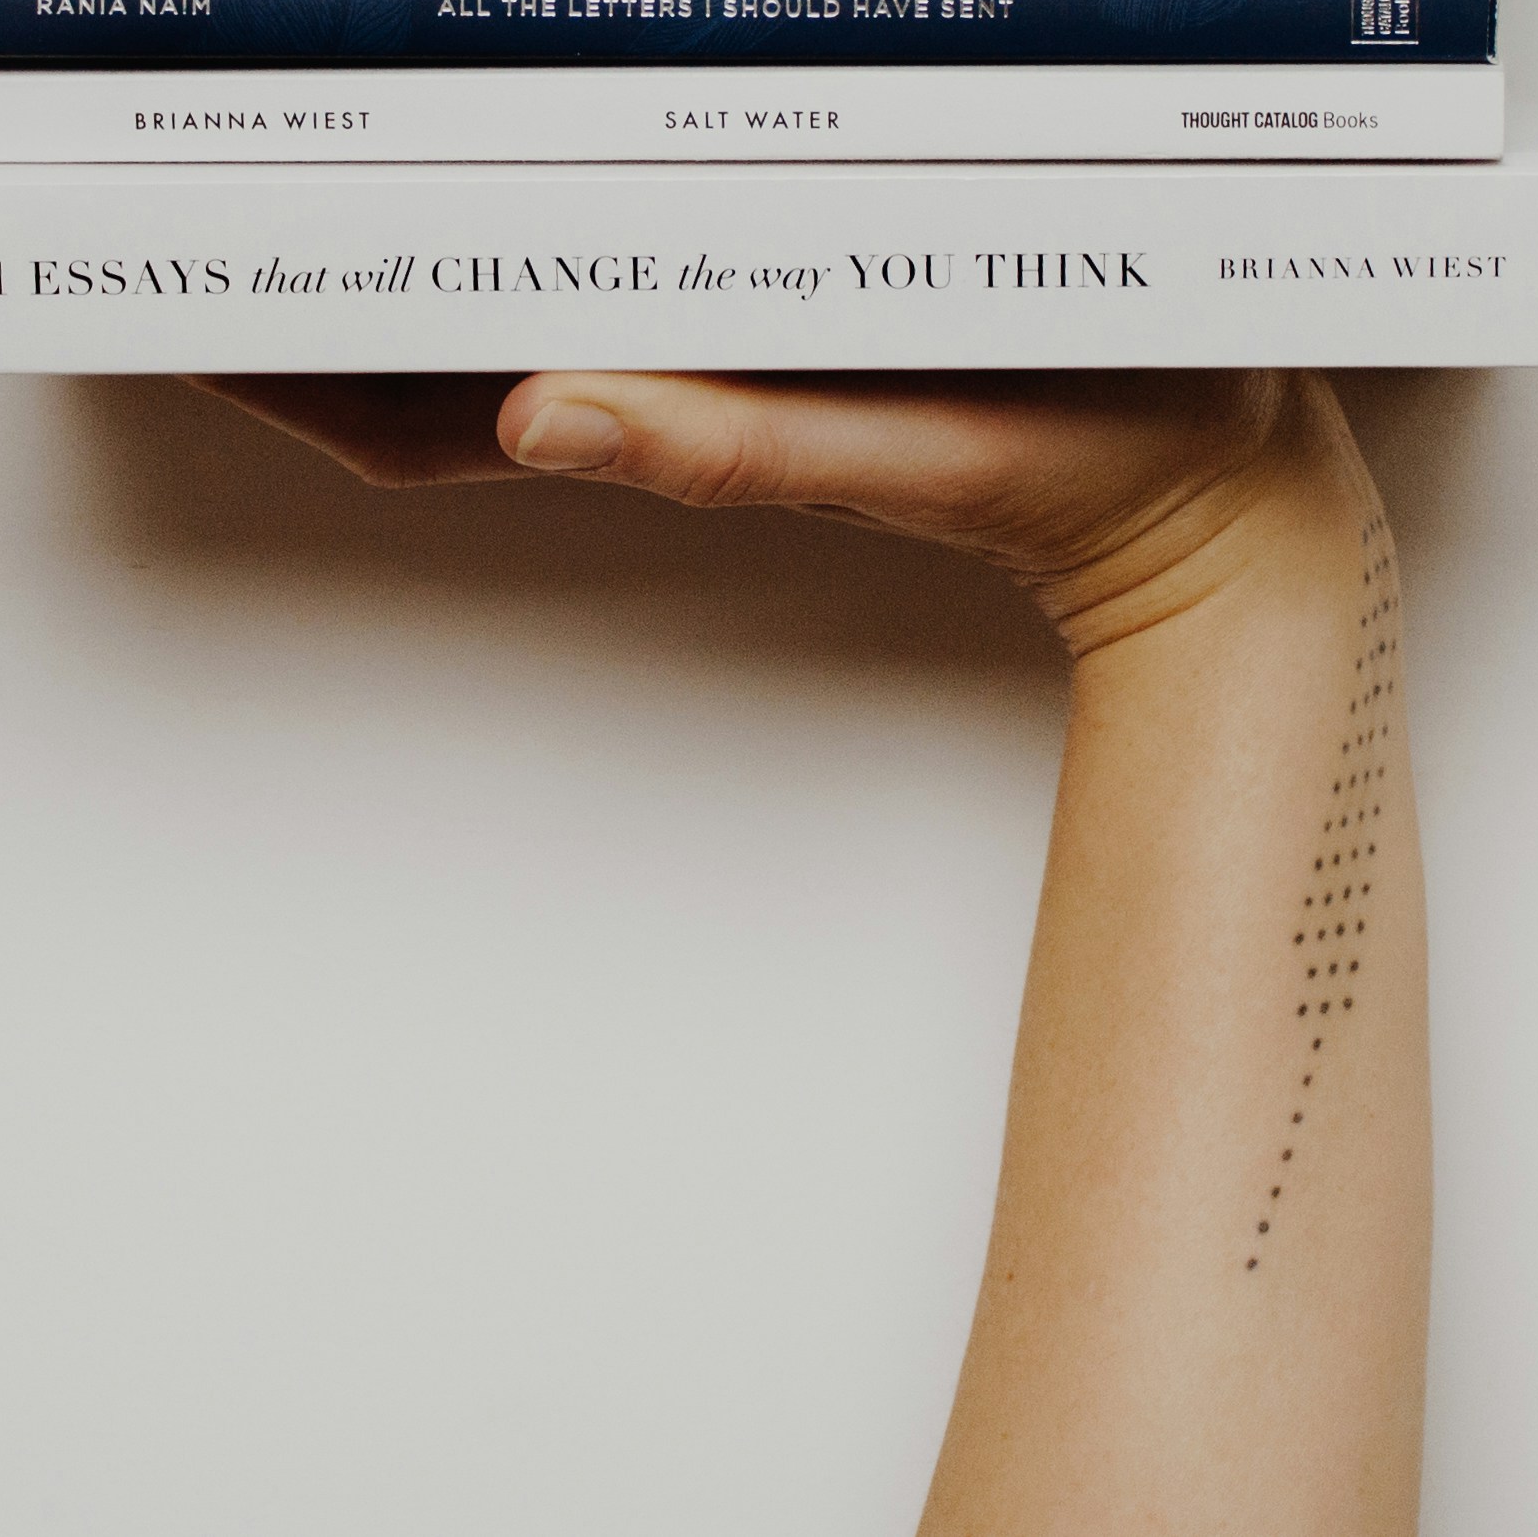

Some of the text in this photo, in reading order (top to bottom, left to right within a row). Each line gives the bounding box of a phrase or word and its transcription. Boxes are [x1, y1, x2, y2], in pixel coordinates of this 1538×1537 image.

[136, 112, 370, 130] BRIANNA WIEST
[666, 111, 839, 130] SALT WATER
[1182, 112, 1379, 129] THOUGHT CATALOG Books
[33, 260, 231, 296] ESSAYS
[252, 258, 327, 294] that
[342, 257, 415, 293] will
[432, 257, 658, 292] CHANGE
[679, 254, 736, 291] the
[750, 268, 831, 301] way
[848, 255, 954, 289] YOU
[976, 254, 1148, 288] THINK
[1221, 257, 1508, 279] BRIANNA WIEST
